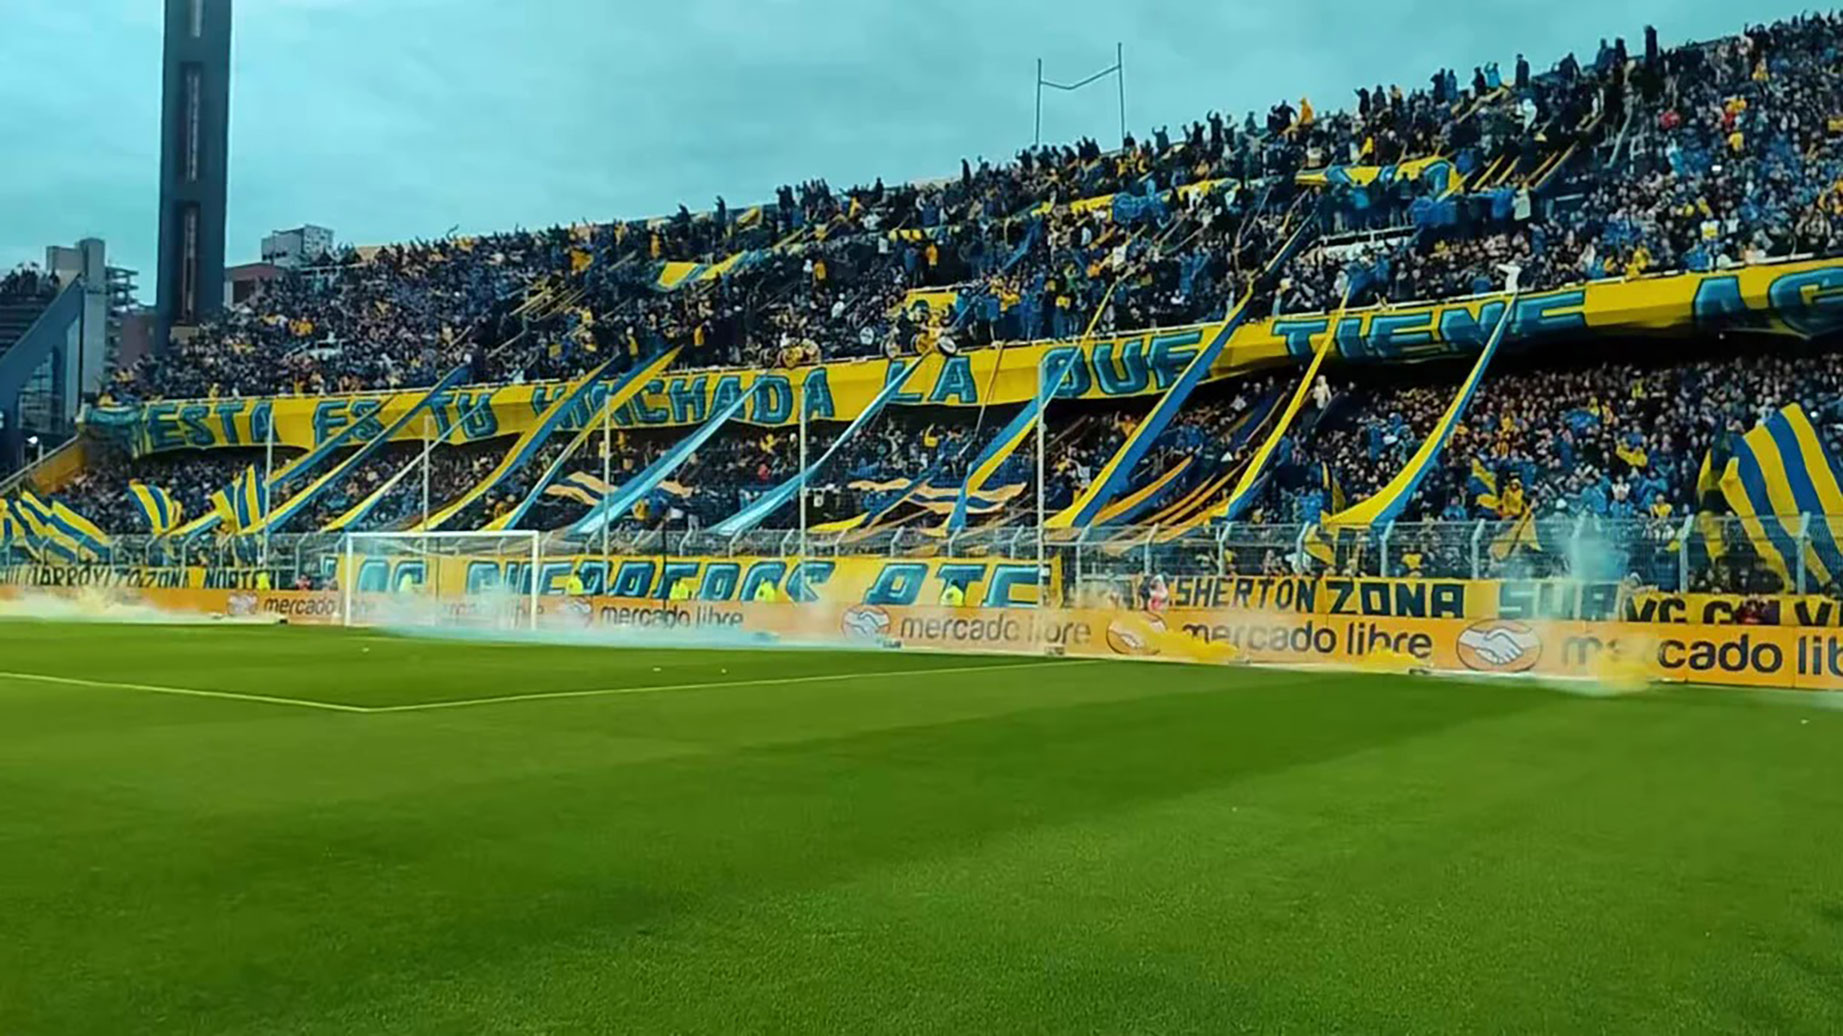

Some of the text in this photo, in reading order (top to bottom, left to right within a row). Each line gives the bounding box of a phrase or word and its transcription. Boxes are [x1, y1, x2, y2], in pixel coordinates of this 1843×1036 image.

[149, 401, 281, 449] ESTA
[422, 391, 499, 440] TU
[885, 357, 977, 403] LA
[263, 596, 336, 616] mercado
[601, 605, 744, 628] mercado libre
[1325, 580, 1464, 618] ZONA
[901, 614, 1020, 641] mercado
[1182, 620, 1432, 659] mercado libre
[1562, 634, 1783, 673] mcado
